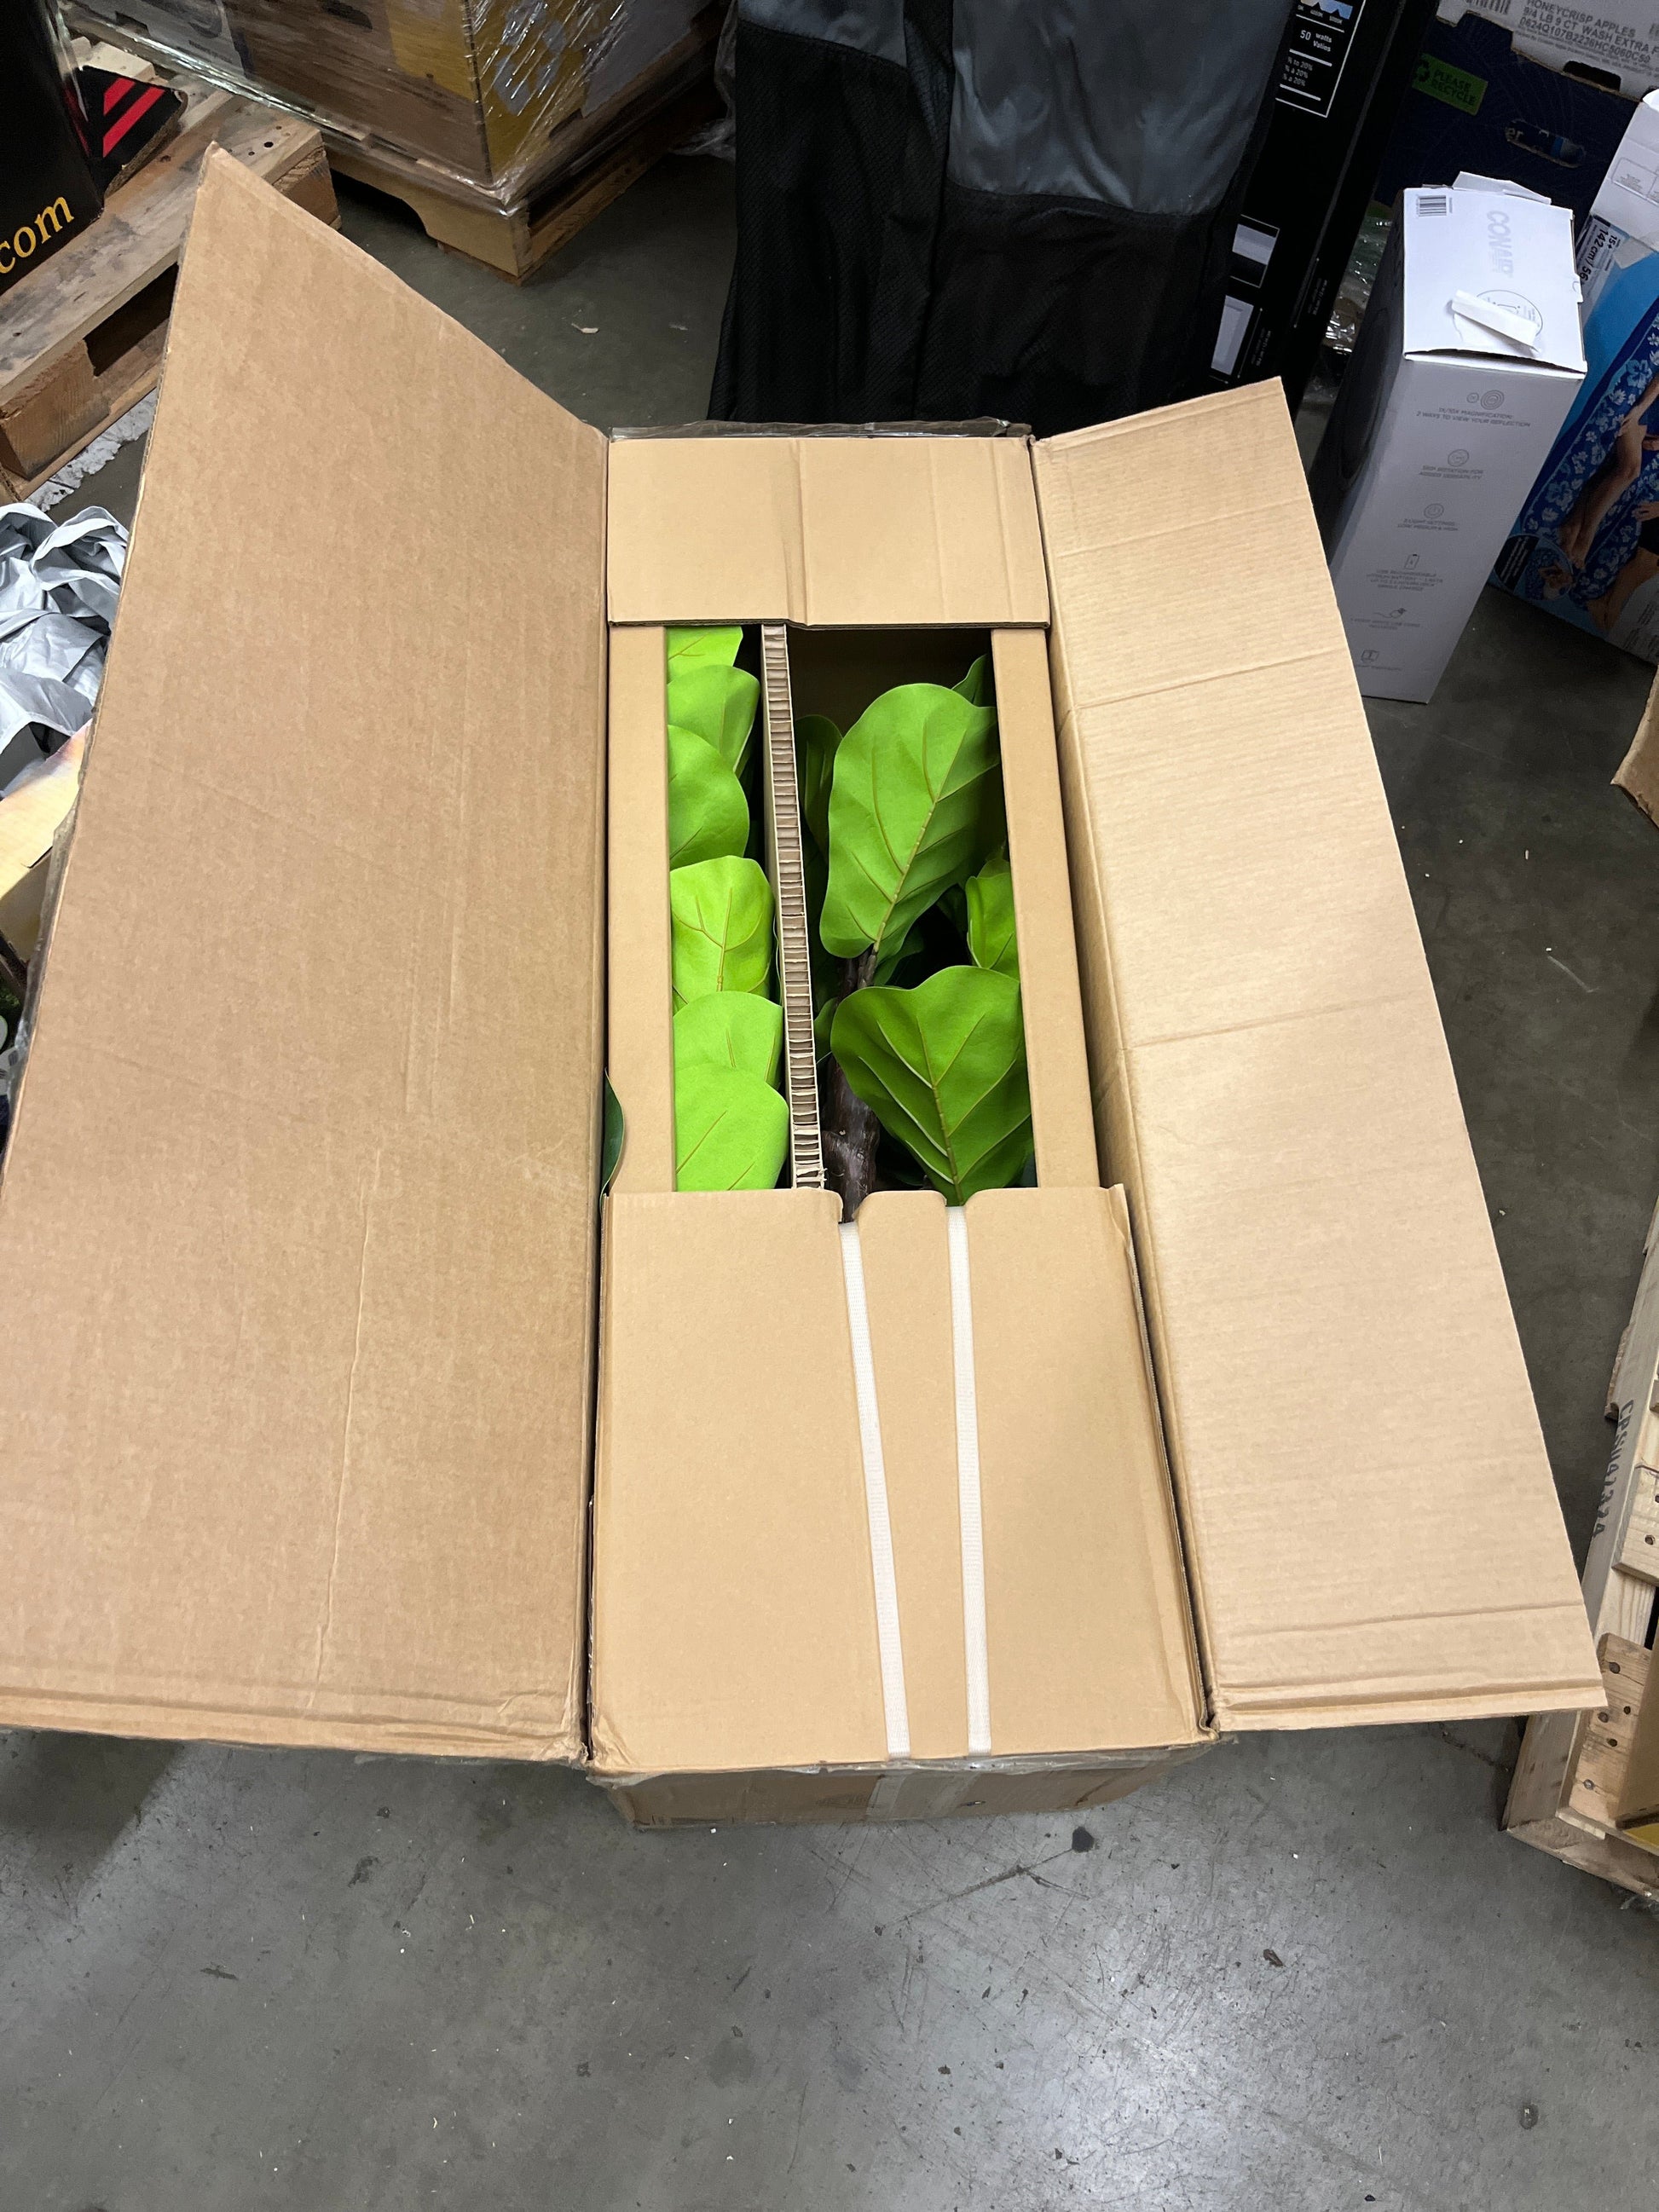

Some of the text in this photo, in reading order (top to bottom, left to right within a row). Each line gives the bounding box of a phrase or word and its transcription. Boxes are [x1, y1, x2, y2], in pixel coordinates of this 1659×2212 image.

[1300, 30, 1332, 43] 50 watts
[1540, 11, 1553, 24] LB
[1564, 20, 1579, 31] CT
[1582, 25, 1613, 43] WASH
[1615, 35, 1650, 53] EXTRA
[1594, 19, 1636, 38] APPLES
[1431, 79, 1477, 107] RECYCLE
[0, 196, 75, 274] com
[1595, 228, 1609, 248] 142
